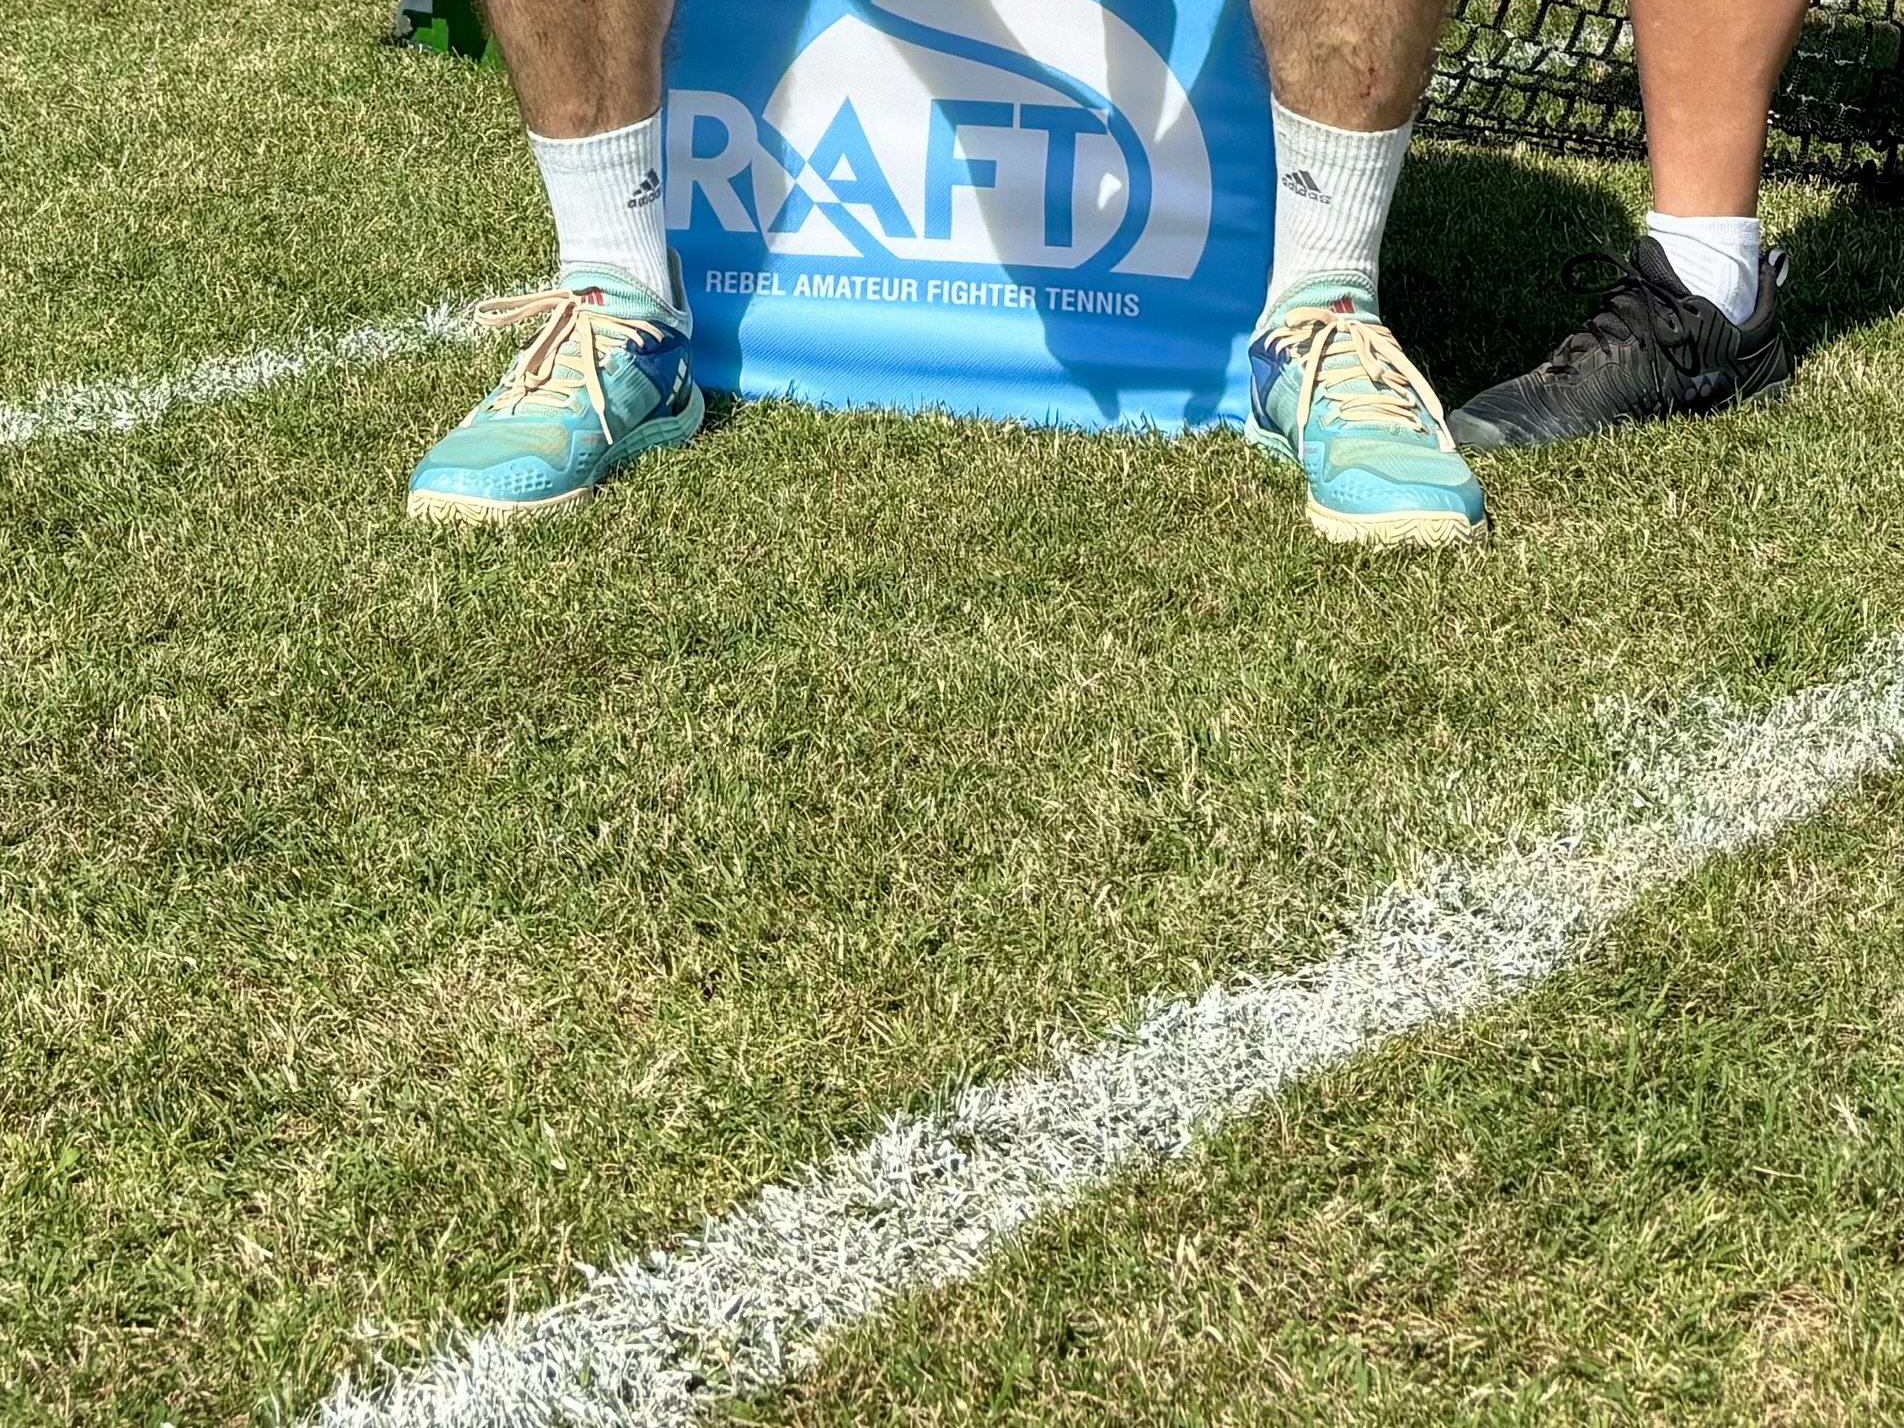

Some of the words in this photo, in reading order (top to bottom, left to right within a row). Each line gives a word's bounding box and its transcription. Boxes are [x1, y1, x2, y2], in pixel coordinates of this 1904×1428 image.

[665, 89, 1108, 248] RAFT
[1282, 177, 1331, 204] adidas
[705, 270, 786, 297] REBEL
[793, 273, 918, 303] AMATEUR
[928, 279, 1036, 308] FIGHTER
[1046, 287, 1141, 318] TENNIS
